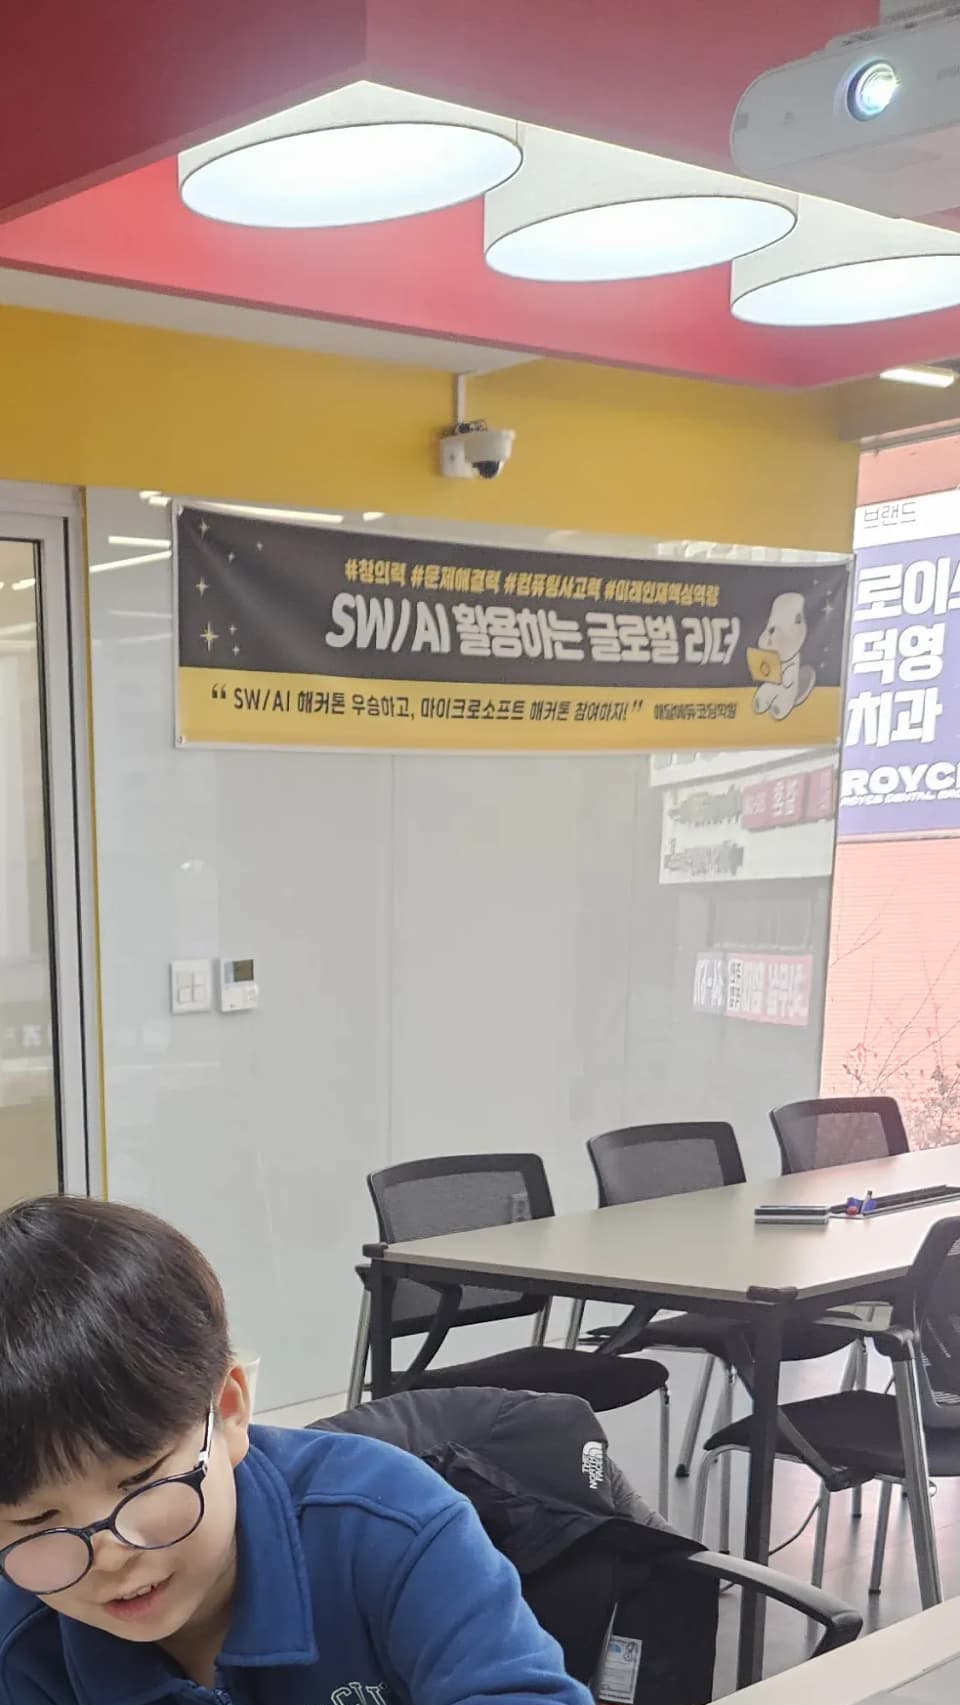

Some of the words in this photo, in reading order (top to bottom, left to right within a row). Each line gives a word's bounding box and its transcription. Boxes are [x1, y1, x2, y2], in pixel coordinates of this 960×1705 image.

[863, 502, 917, 528] 브랜드
[325, 592, 451, 654] SW/AI
[451, 603, 584, 660] 활용하는
[585, 612, 679, 664] 글로벌
[681, 617, 740, 666] 리더
[851, 622, 947, 686] 덕영
[233, 687, 290, 713] SW/AI
[297, 691, 345, 715] 해커톤
[351, 694, 415, 721] 우승하고,
[421, 697, 525, 721] 마이크로소프트
[529, 701, 569, 721] 해커톤
[844, 687, 942, 748] 치과
